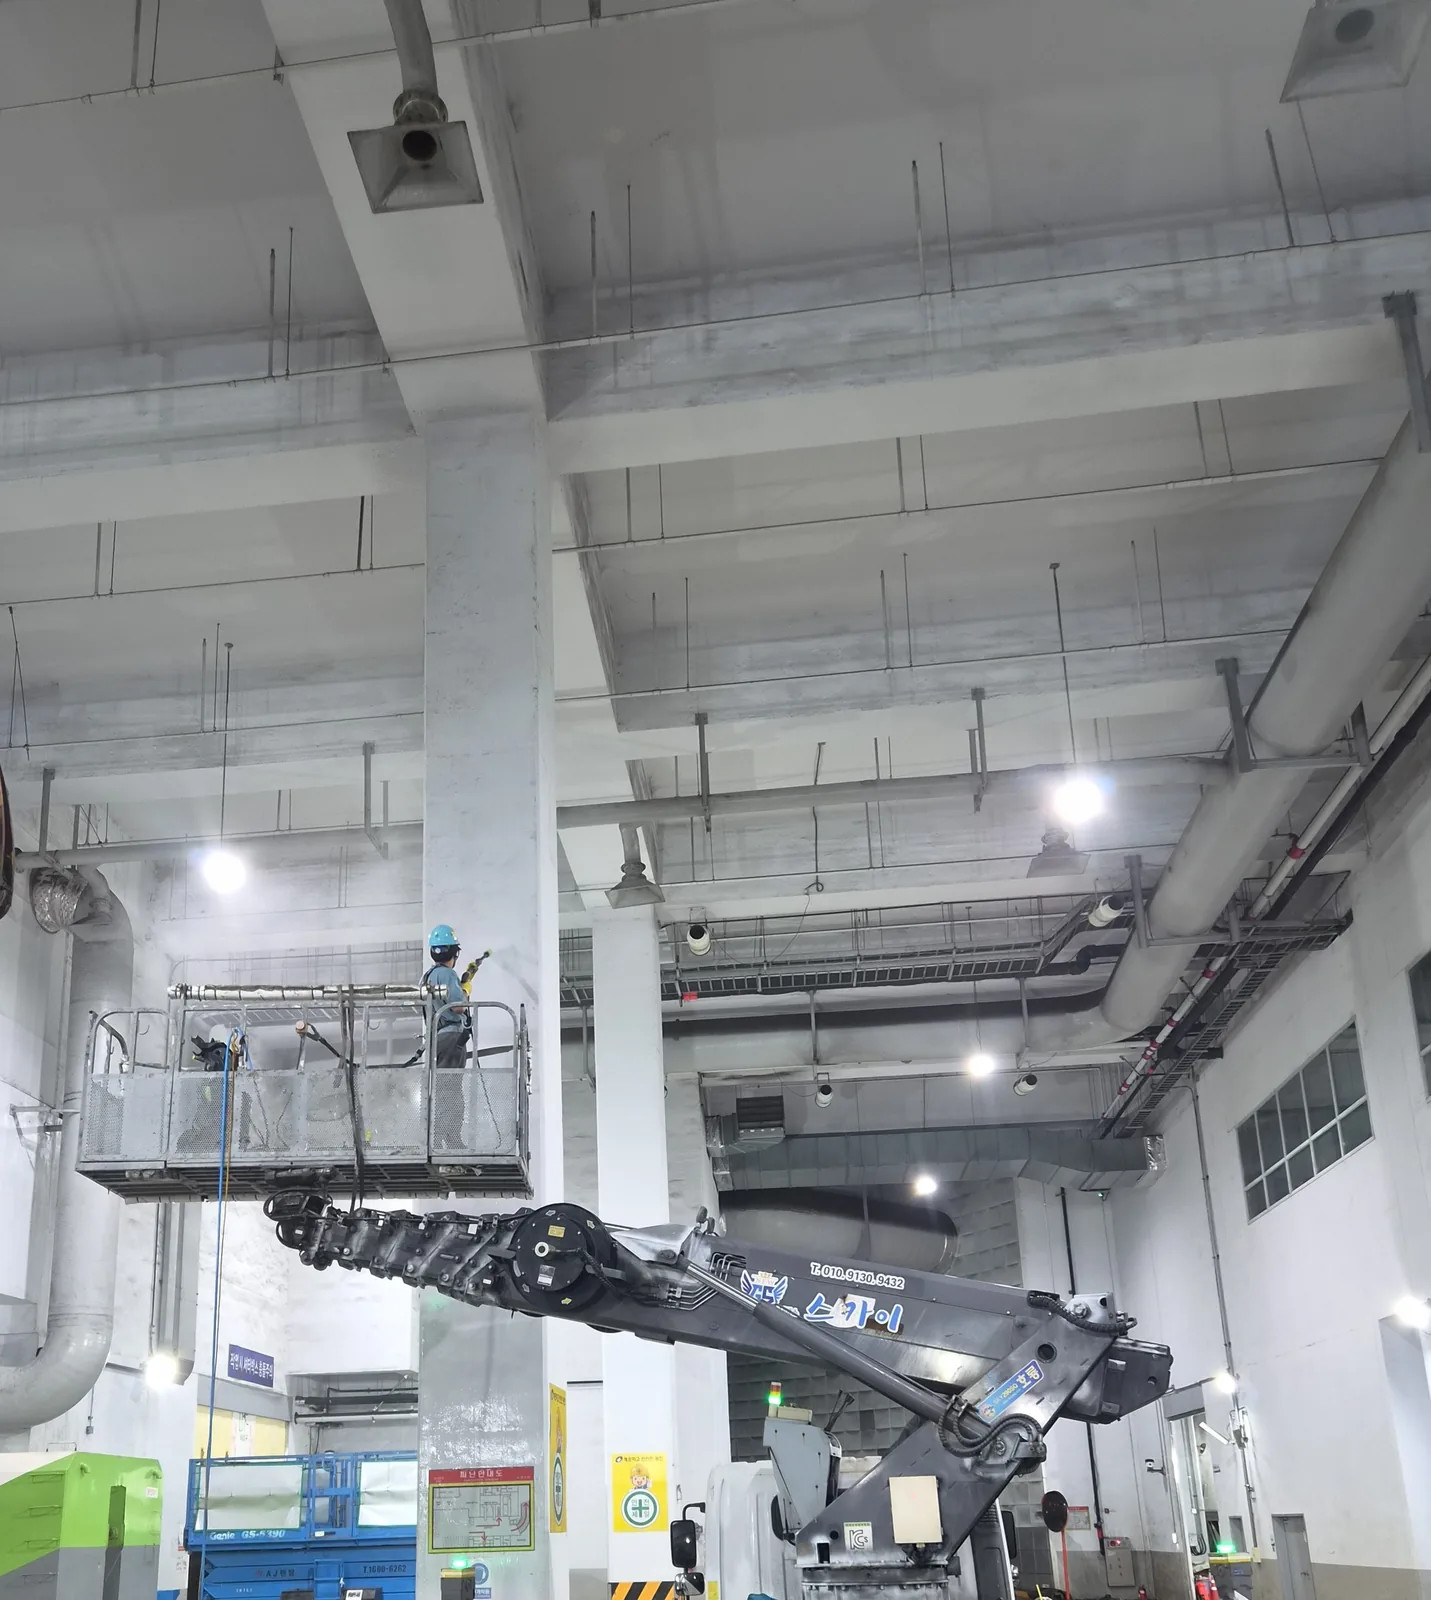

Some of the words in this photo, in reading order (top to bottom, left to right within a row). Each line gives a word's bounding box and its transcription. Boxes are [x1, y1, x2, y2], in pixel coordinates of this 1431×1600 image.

[804, 1293, 903, 1332] 스카이
[1016, 1365, 1041, 1389] 호룡
[210, 1531, 236, 1541] Genie
